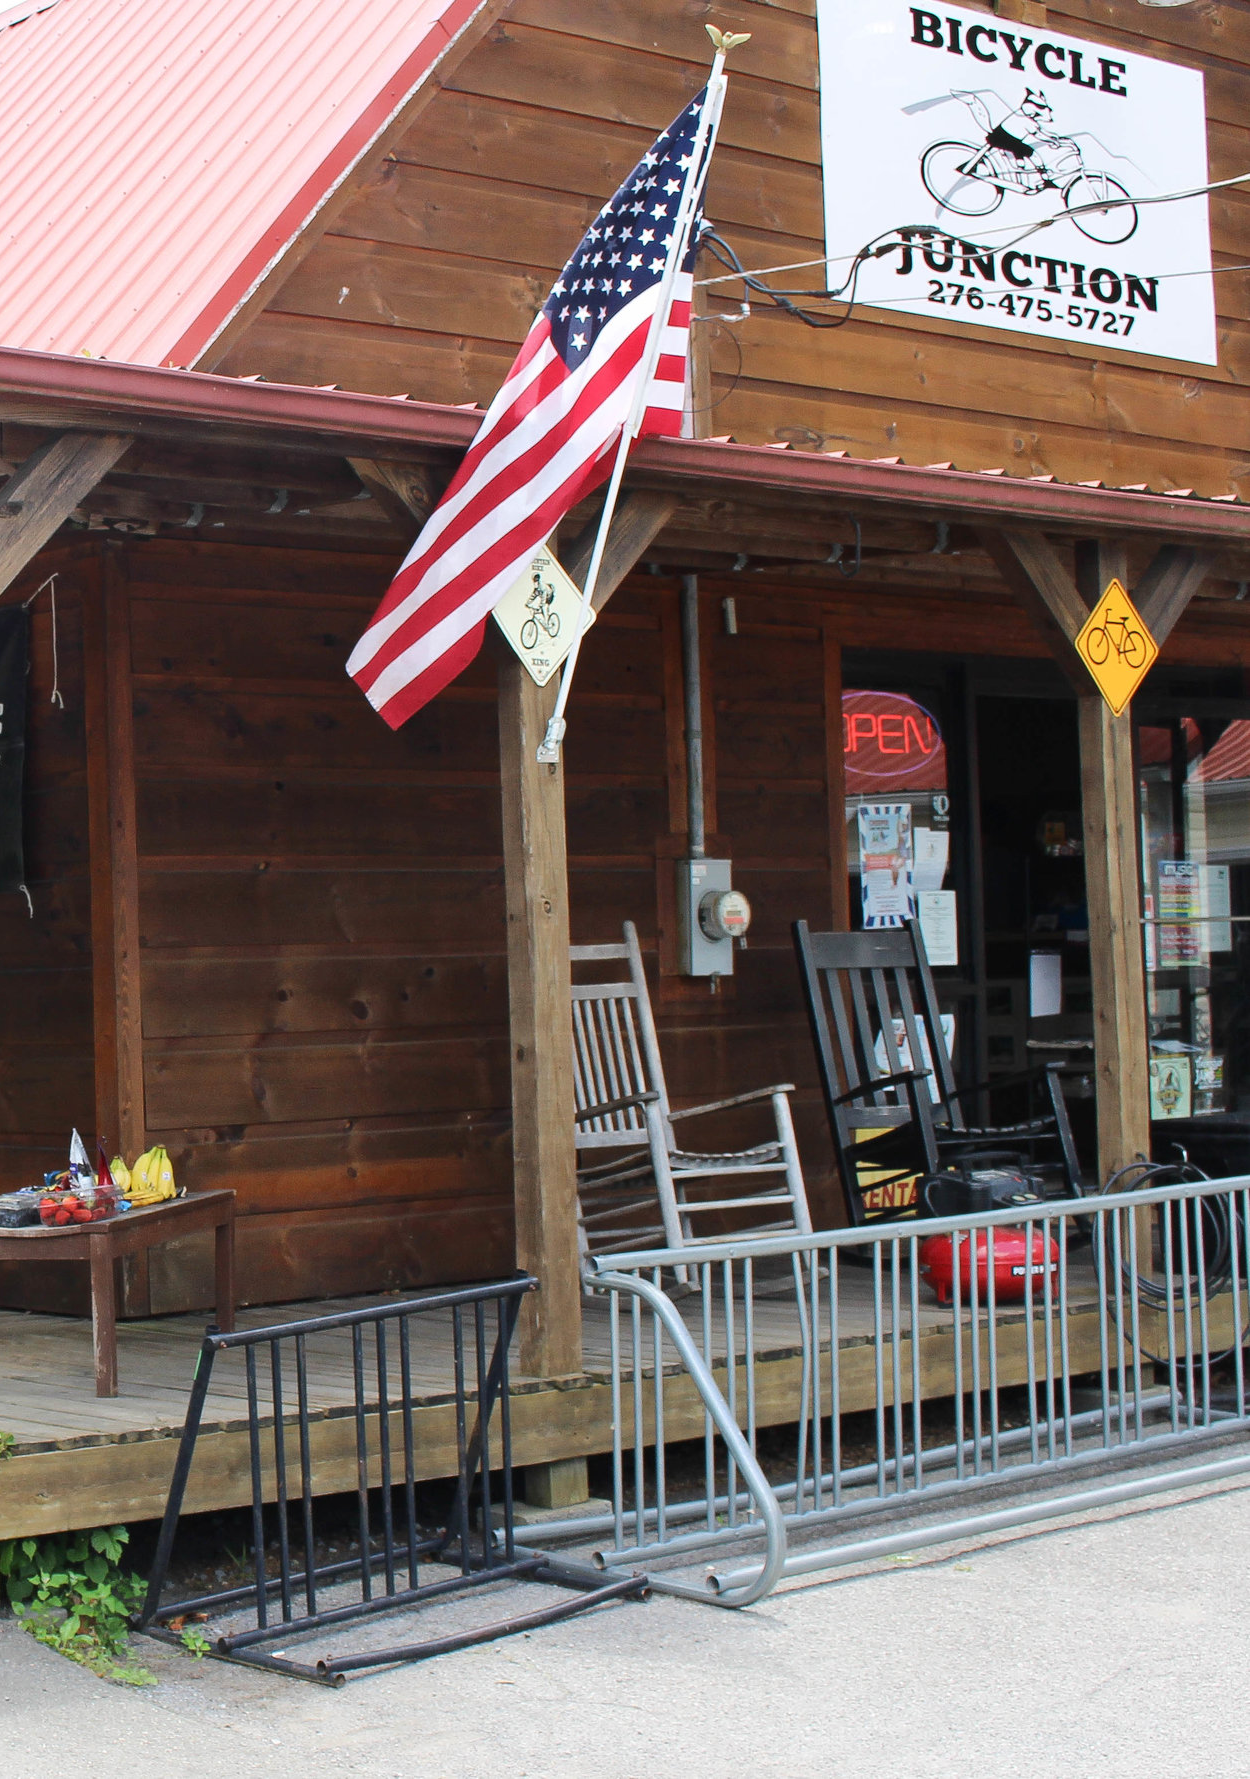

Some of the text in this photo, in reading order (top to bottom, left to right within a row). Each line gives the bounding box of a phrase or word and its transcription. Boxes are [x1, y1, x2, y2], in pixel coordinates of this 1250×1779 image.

[908, 6, 1128, 98] BICYCLE
[895, 229, 1159, 313] JUNCTION
[927, 279, 1136, 337] 276-475-5727
[861, 1181, 918, 1209] ENTA
[1012, 1264, 1039, 1276] POER
